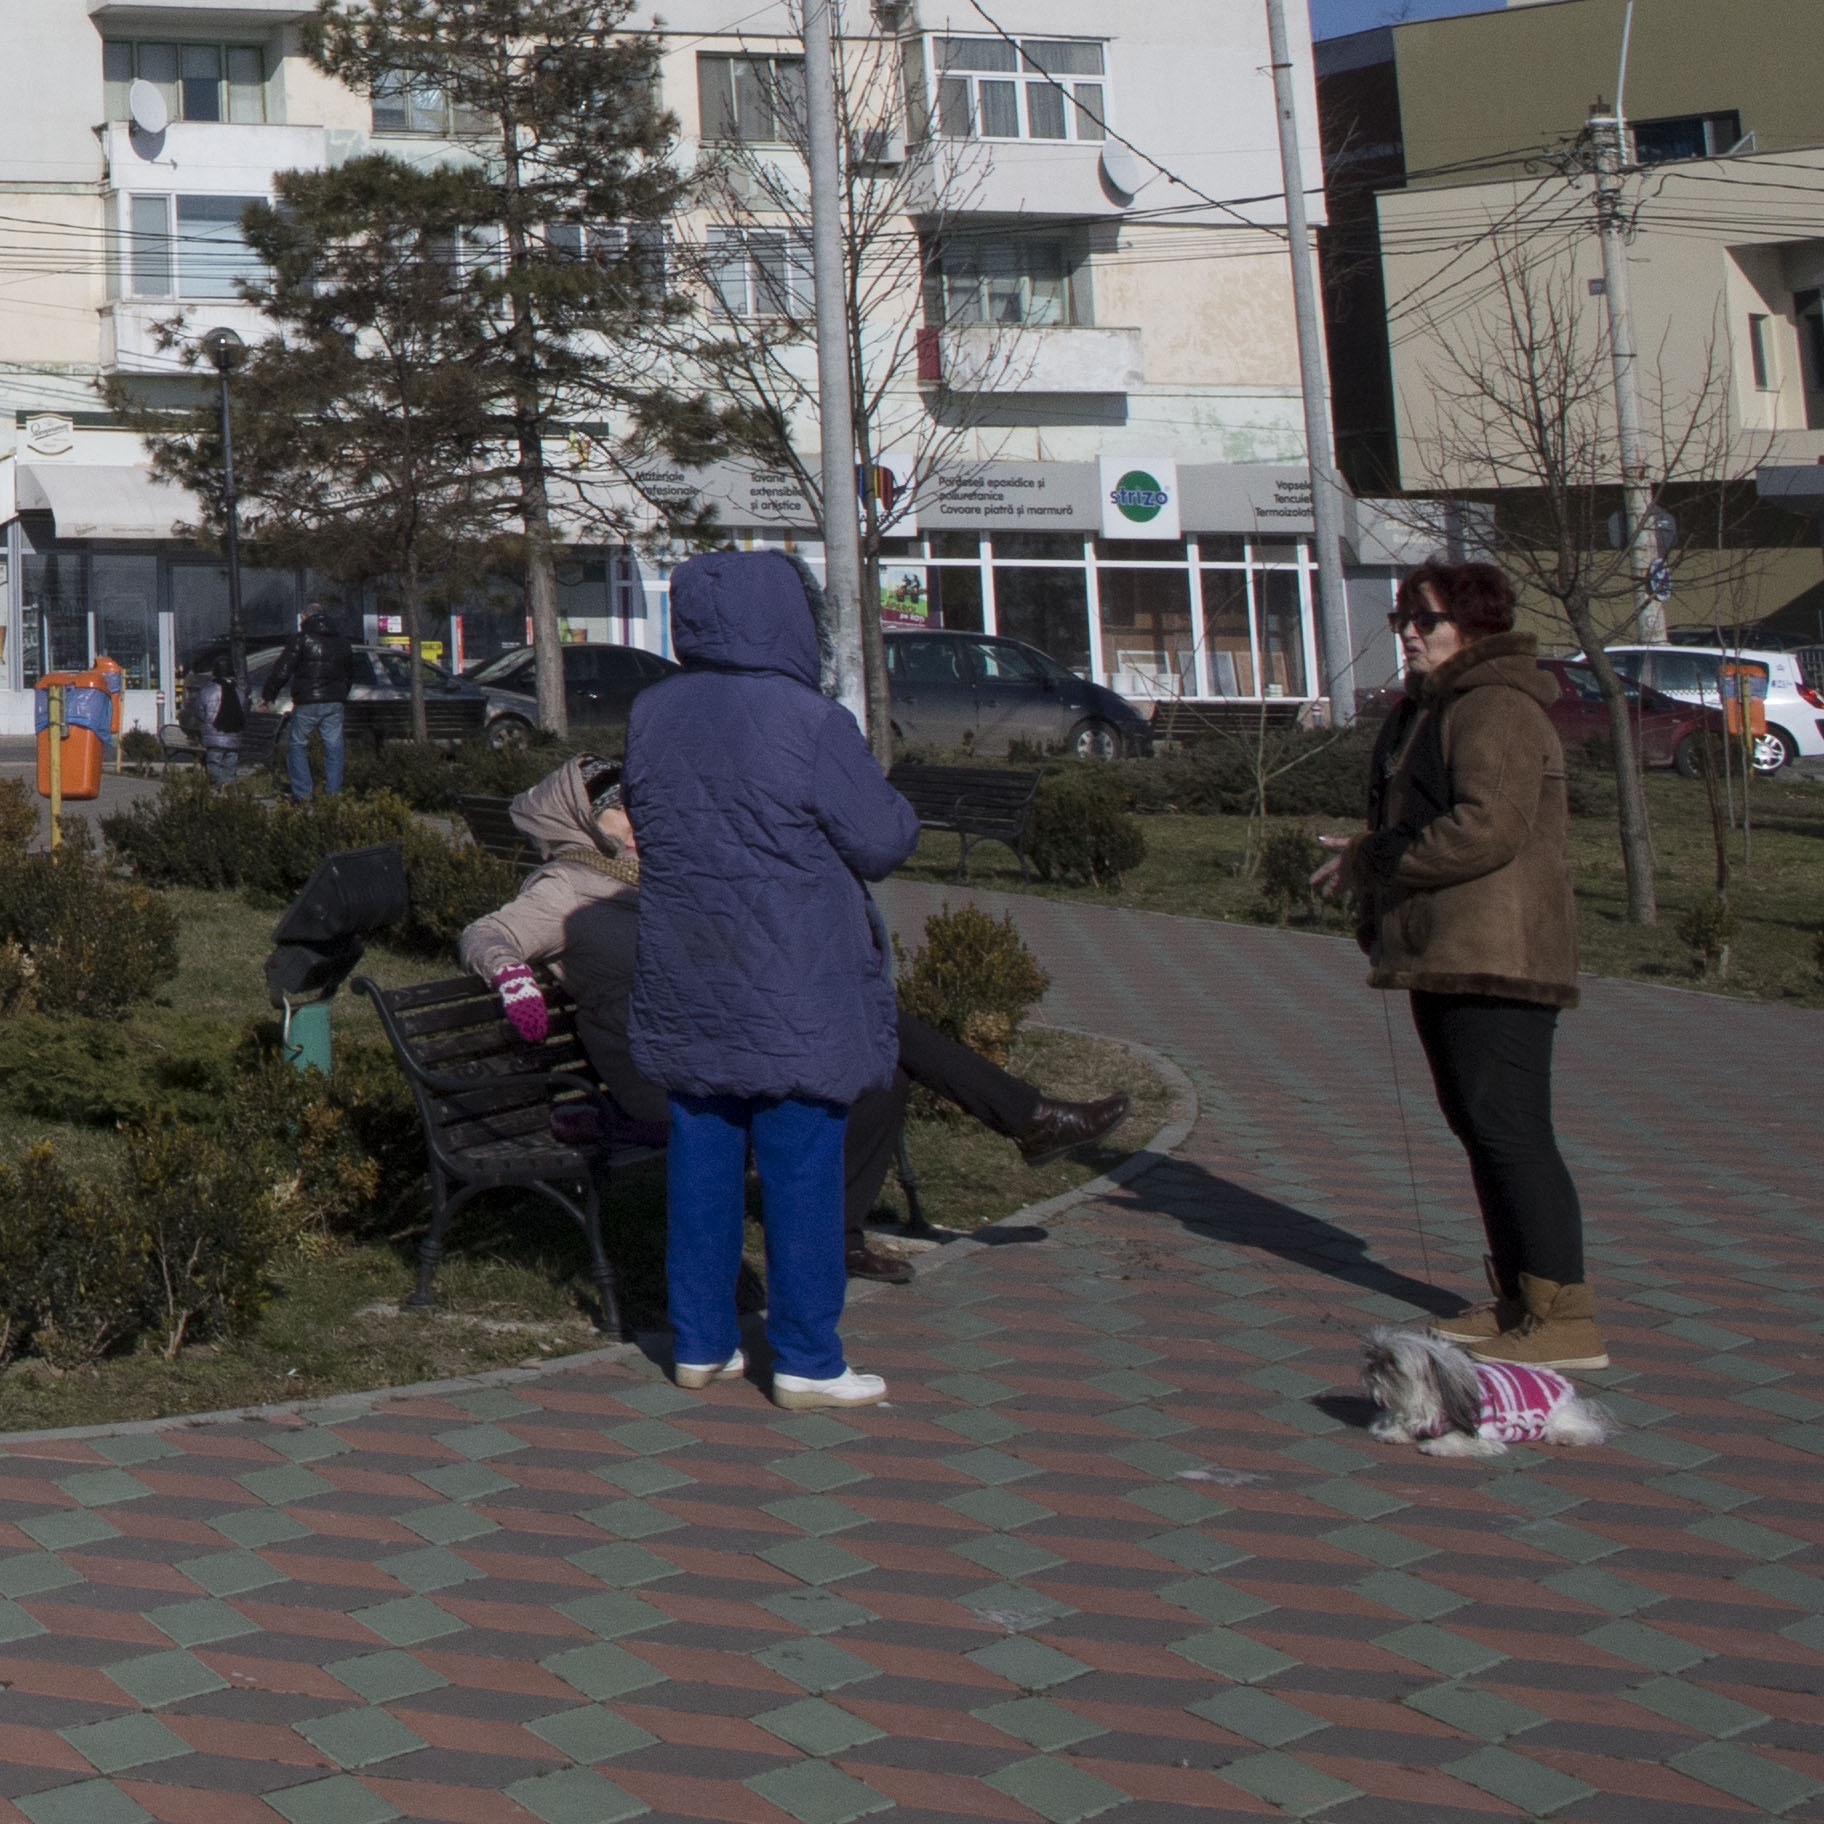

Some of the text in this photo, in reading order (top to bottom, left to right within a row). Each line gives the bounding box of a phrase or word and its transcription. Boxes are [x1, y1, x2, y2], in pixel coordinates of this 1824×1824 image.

[987, 478, 1035, 489] epoxidice
[638, 486, 700, 497] rofesionale
[1110, 485, 1169, 508] strizo
[940, 504, 981, 515] Covoare
